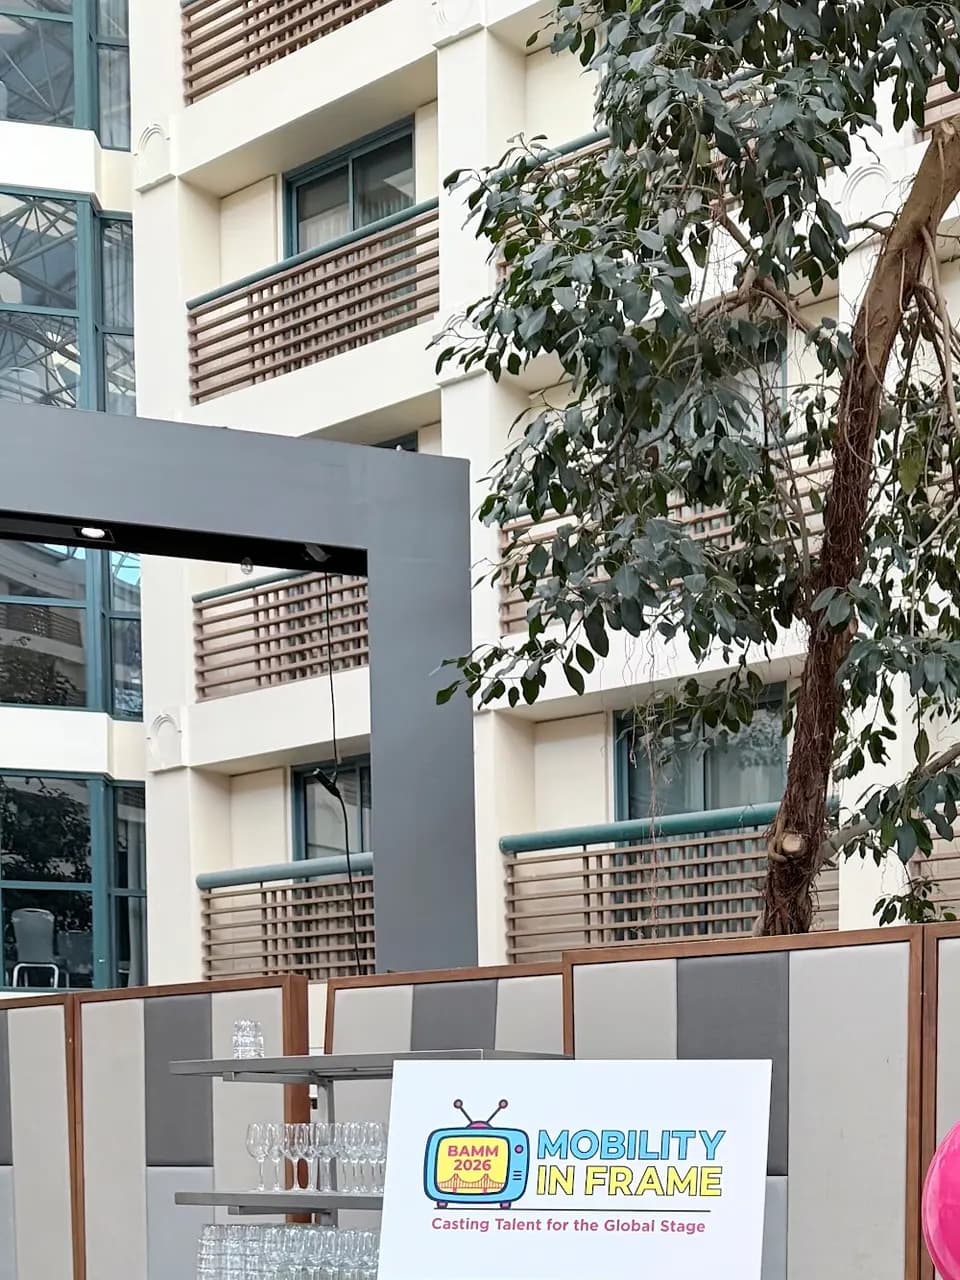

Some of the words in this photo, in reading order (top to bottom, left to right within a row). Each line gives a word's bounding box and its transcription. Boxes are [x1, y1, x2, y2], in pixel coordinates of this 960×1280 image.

[447, 1145, 499, 1158] BAMM
[536, 1128, 727, 1162] MOBILITY
[453, 1159, 492, 1172] 2026
[536, 1165, 577, 1196] IN
[584, 1165, 724, 1198] FRAME
[431, 1218, 490, 1233] Casting
[495, 1218, 543, 1231] Talent
[546, 1218, 570, 1232] for
[573, 1219, 599, 1232] the
[603, 1219, 656, 1233] Global
[660, 1219, 706, 1236] Stage
